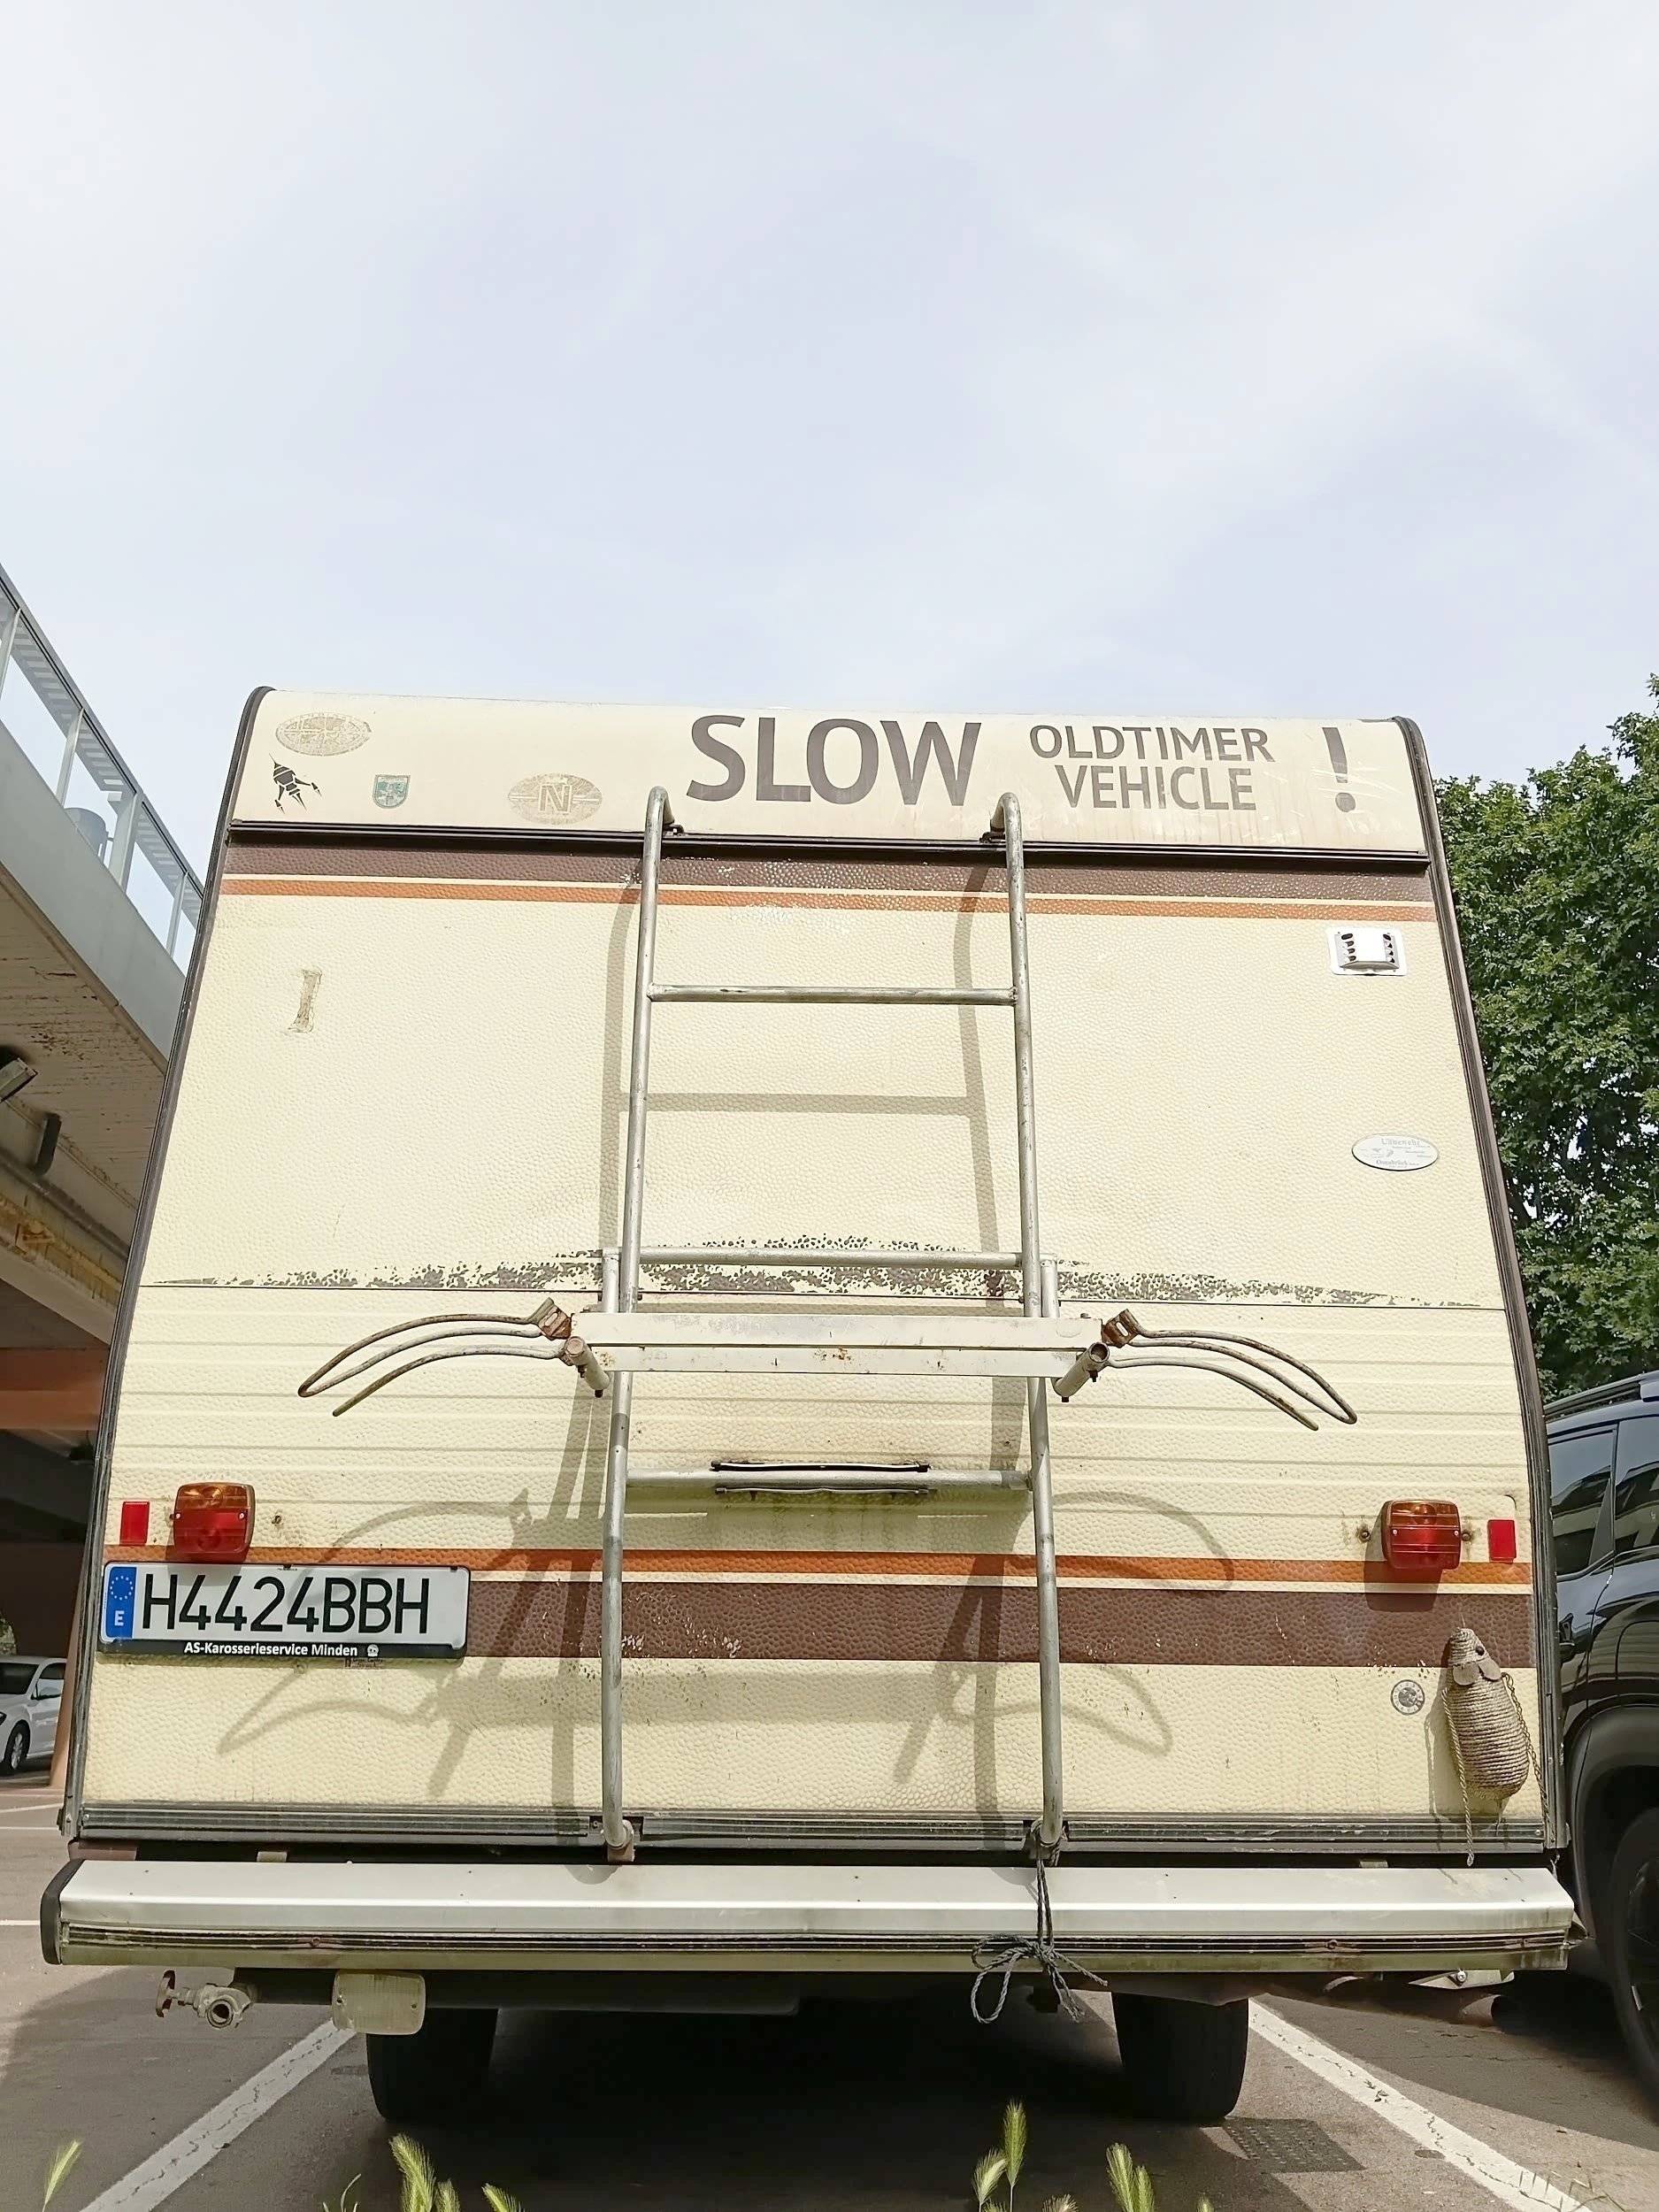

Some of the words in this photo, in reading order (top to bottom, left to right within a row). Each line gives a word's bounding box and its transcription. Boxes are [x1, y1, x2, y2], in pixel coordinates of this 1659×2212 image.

[687, 715, 982, 806] SLOW
[1030, 726, 1275, 763] OLDTIMER
[1054, 764, 1256, 811] VEHICLE
[114, 1610, 125, 1626] E
[142, 1573, 430, 1634] H4424BBH
[183, 1641, 309, 1656] AS-Karosserieservice
[311, 1643, 358, 1656] Minden
